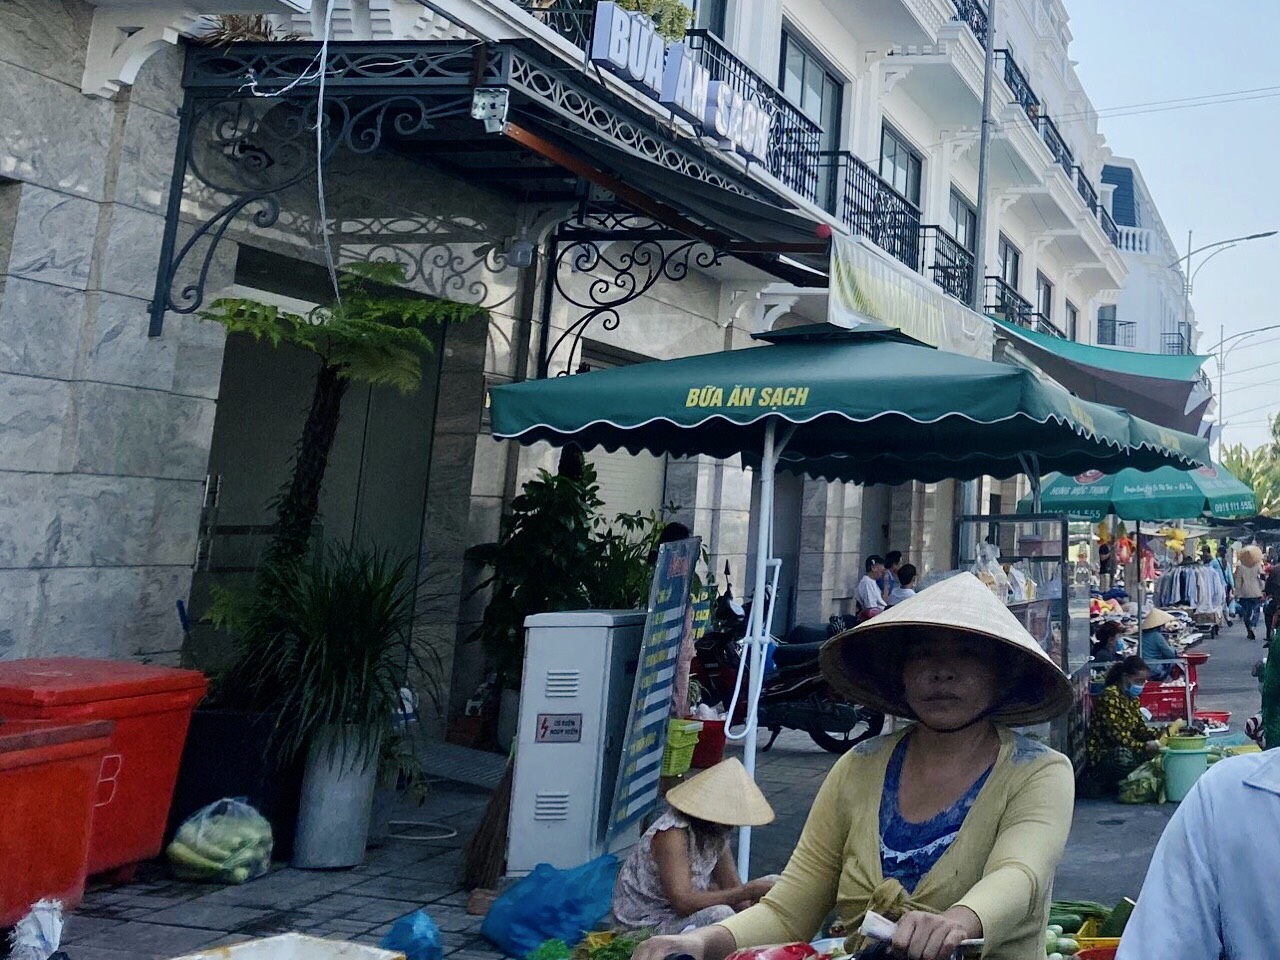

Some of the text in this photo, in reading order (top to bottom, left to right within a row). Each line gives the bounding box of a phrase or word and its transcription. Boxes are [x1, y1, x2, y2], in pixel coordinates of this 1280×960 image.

[602, 3, 666, 96] BỮA
[667, 37, 711, 123] ĂN
[685, 384, 810, 411] BỮA ĂN SẠCH
